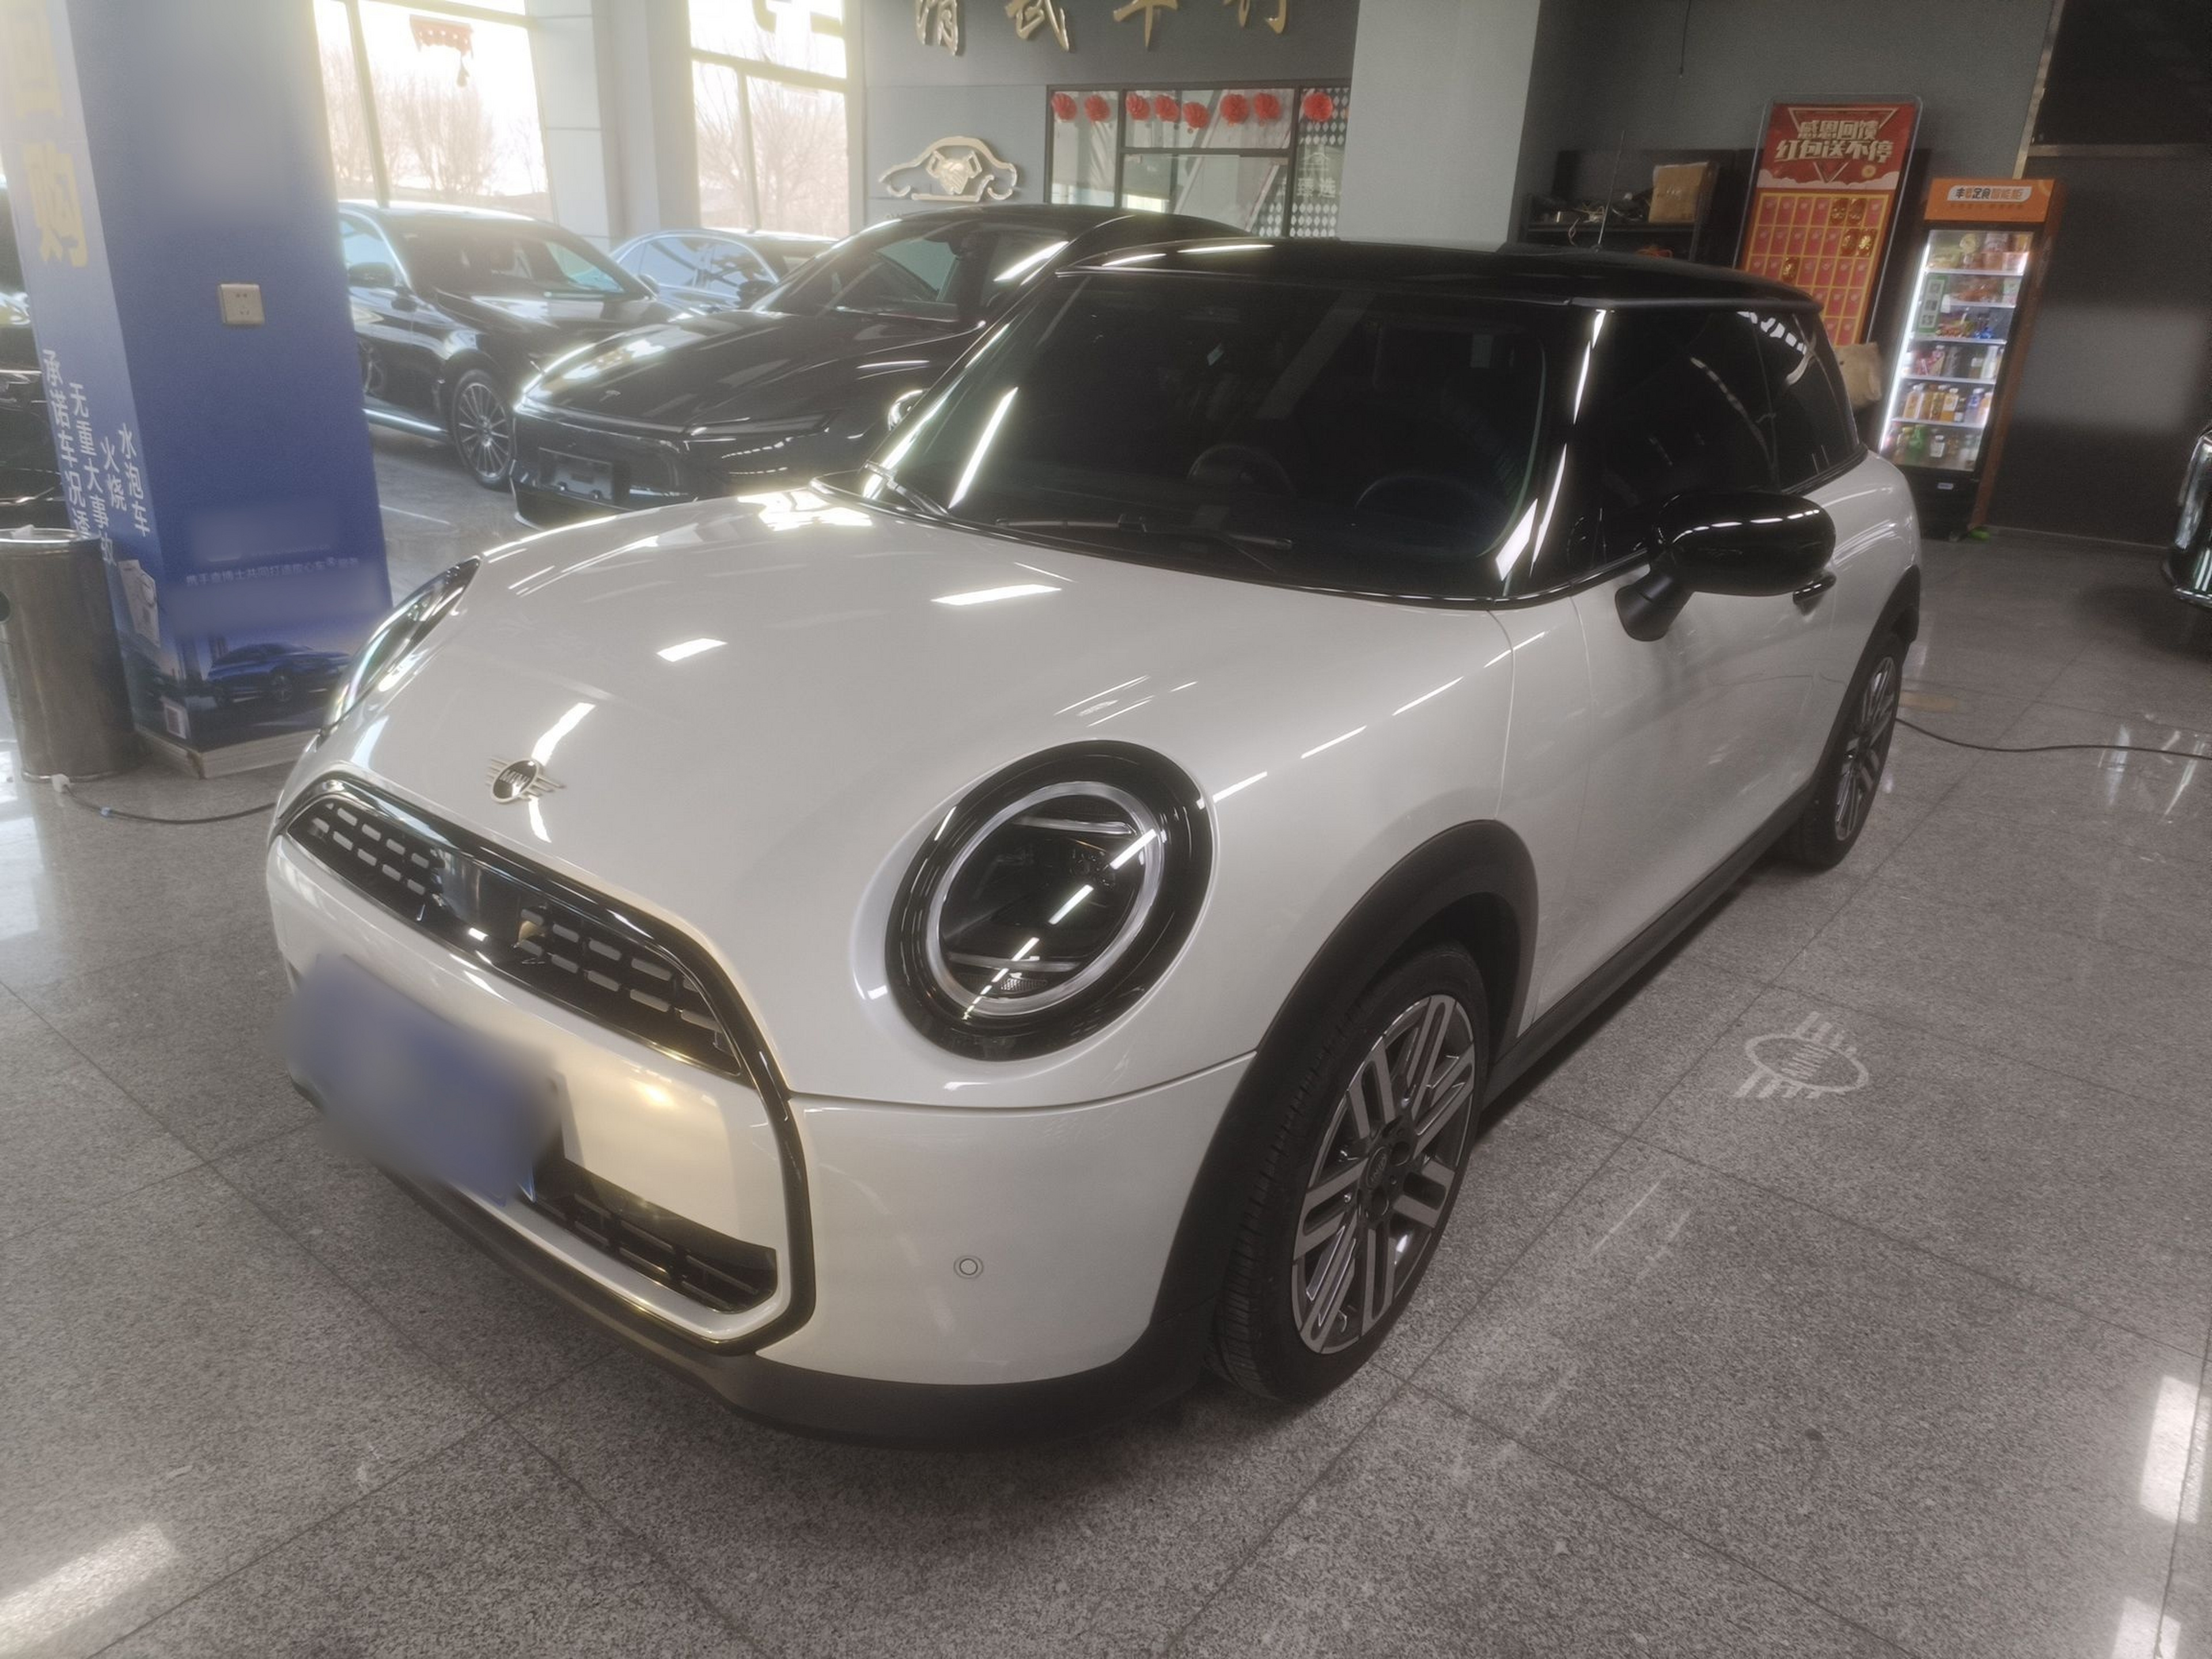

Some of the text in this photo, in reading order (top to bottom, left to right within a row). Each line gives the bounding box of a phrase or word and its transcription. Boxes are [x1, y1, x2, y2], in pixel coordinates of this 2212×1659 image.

[1797, 119, 1880, 141] 感恩回馈
[1774, 139, 1894, 164] 红包送不停
[100, 436, 128, 512] 火烧
[118, 422, 151, 538] 水泡车
[499, 770, 531, 786] MINI
